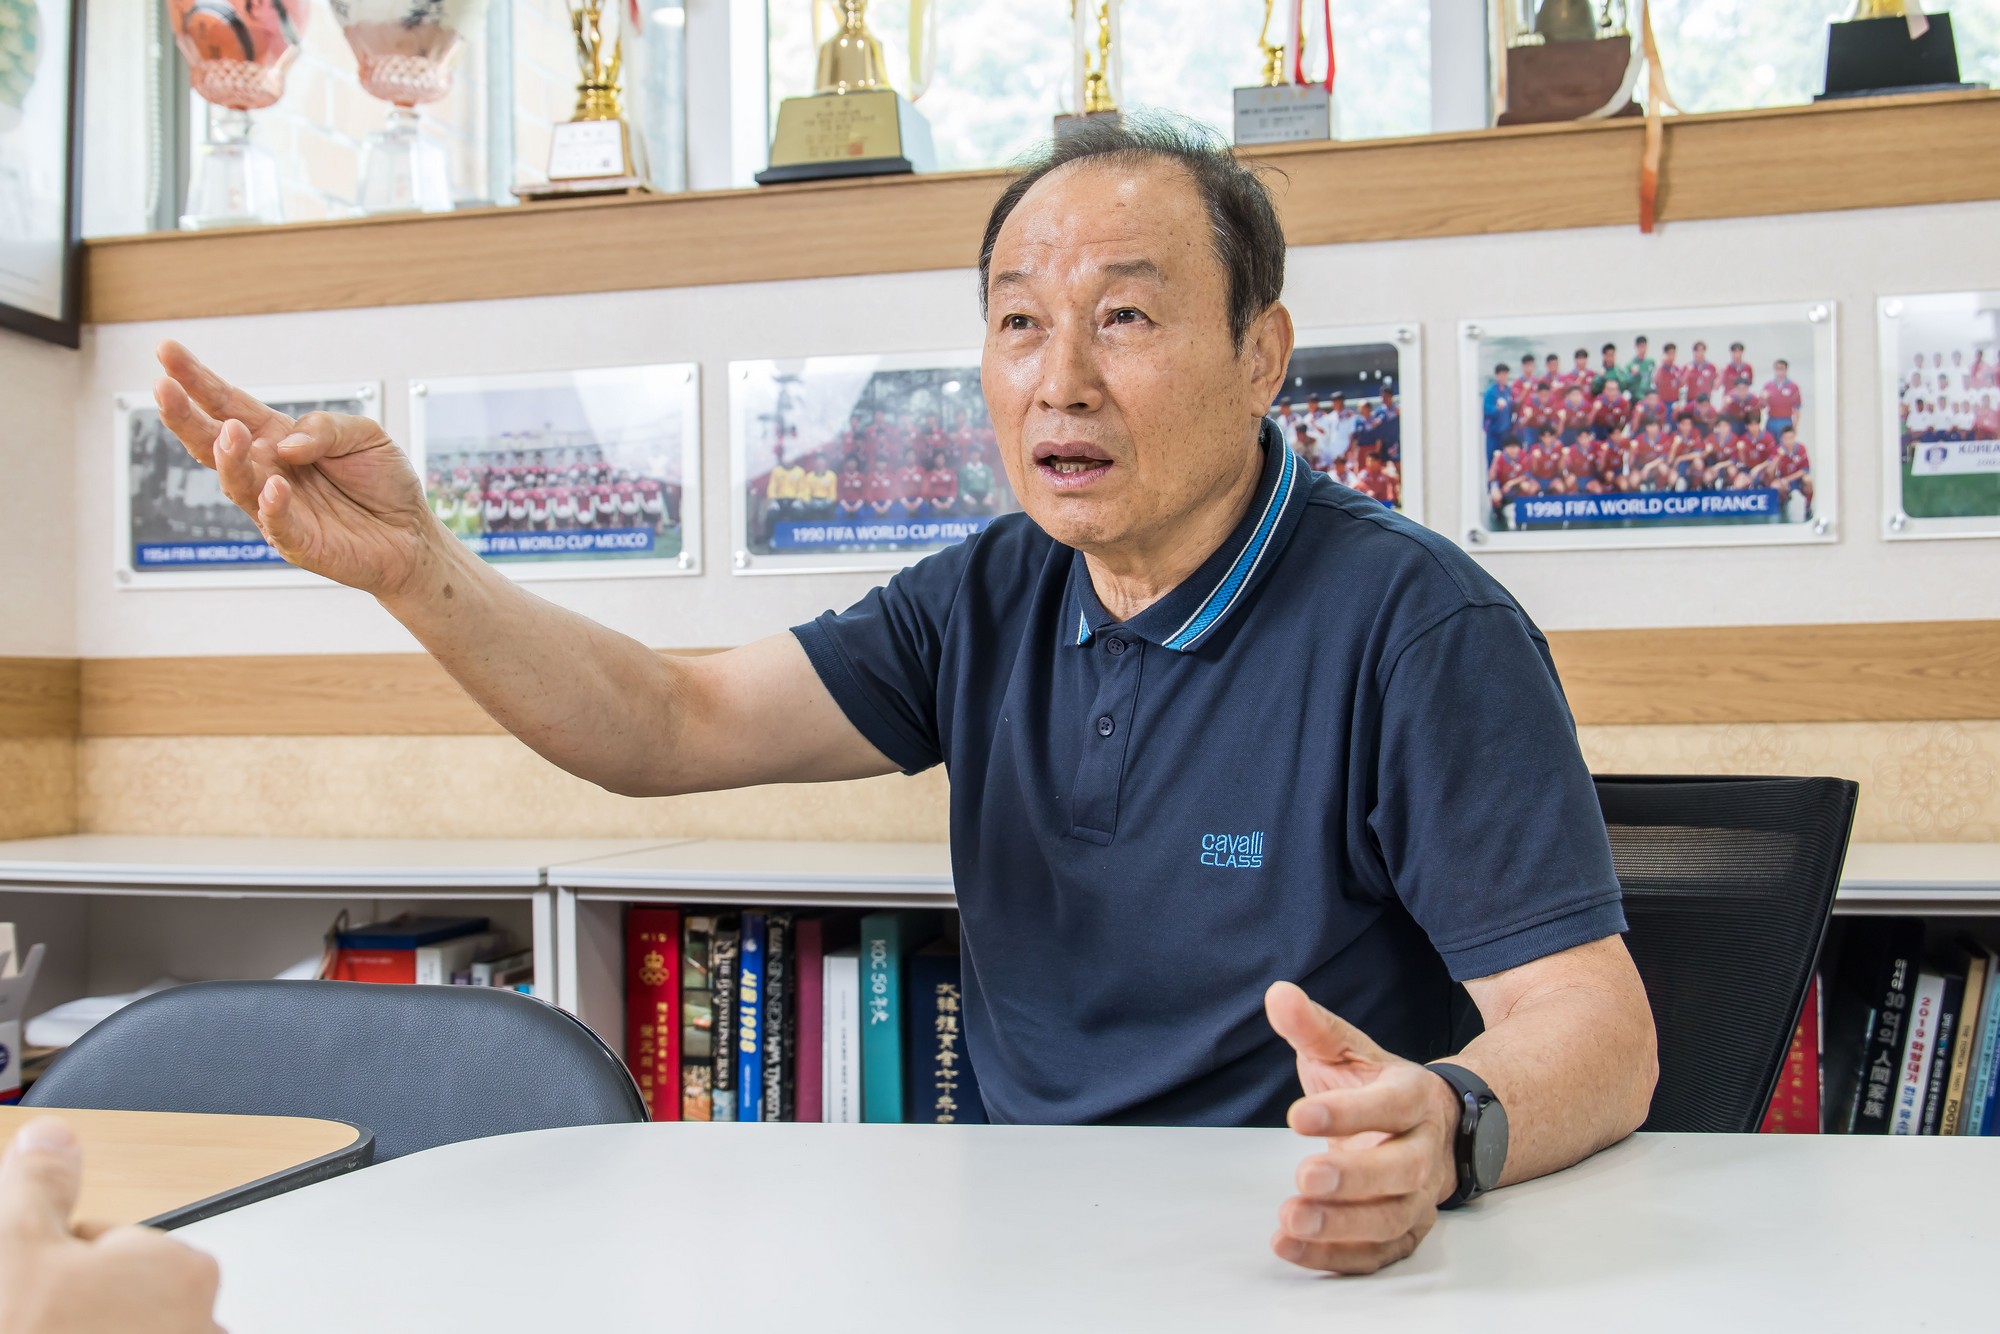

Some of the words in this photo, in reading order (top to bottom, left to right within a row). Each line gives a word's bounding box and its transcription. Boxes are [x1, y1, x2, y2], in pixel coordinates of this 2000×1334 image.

[1524, 501, 1564, 518] 1998
[1565, 500, 1598, 516] FIFA
[1600, 498, 1662, 516] WORLD
[1664, 497, 1699, 514] CUP
[1701, 494, 1769, 512] FRANCE
[491, 537, 517, 552] FIFA
[517, 535, 565, 551] WORLD
[566, 534, 593, 549] CUP
[595, 532, 648, 548] MEXICO
[792, 527, 825, 543] 1990
[826, 526, 854, 541] FIFA
[856, 524, 908, 541] WORLD
[909, 524, 939, 540] CUP
[940, 523, 979, 538] ITALY
[169, 546, 194, 561] FIFA
[196, 545, 238, 561] WORLD
[239, 544, 266, 559] CUP
[1201, 831, 1264, 854] cavalli
[1200, 852, 1263, 868] CLASS
[870, 939, 887, 969] KOC
[740, 1006, 758, 1054] 1988
